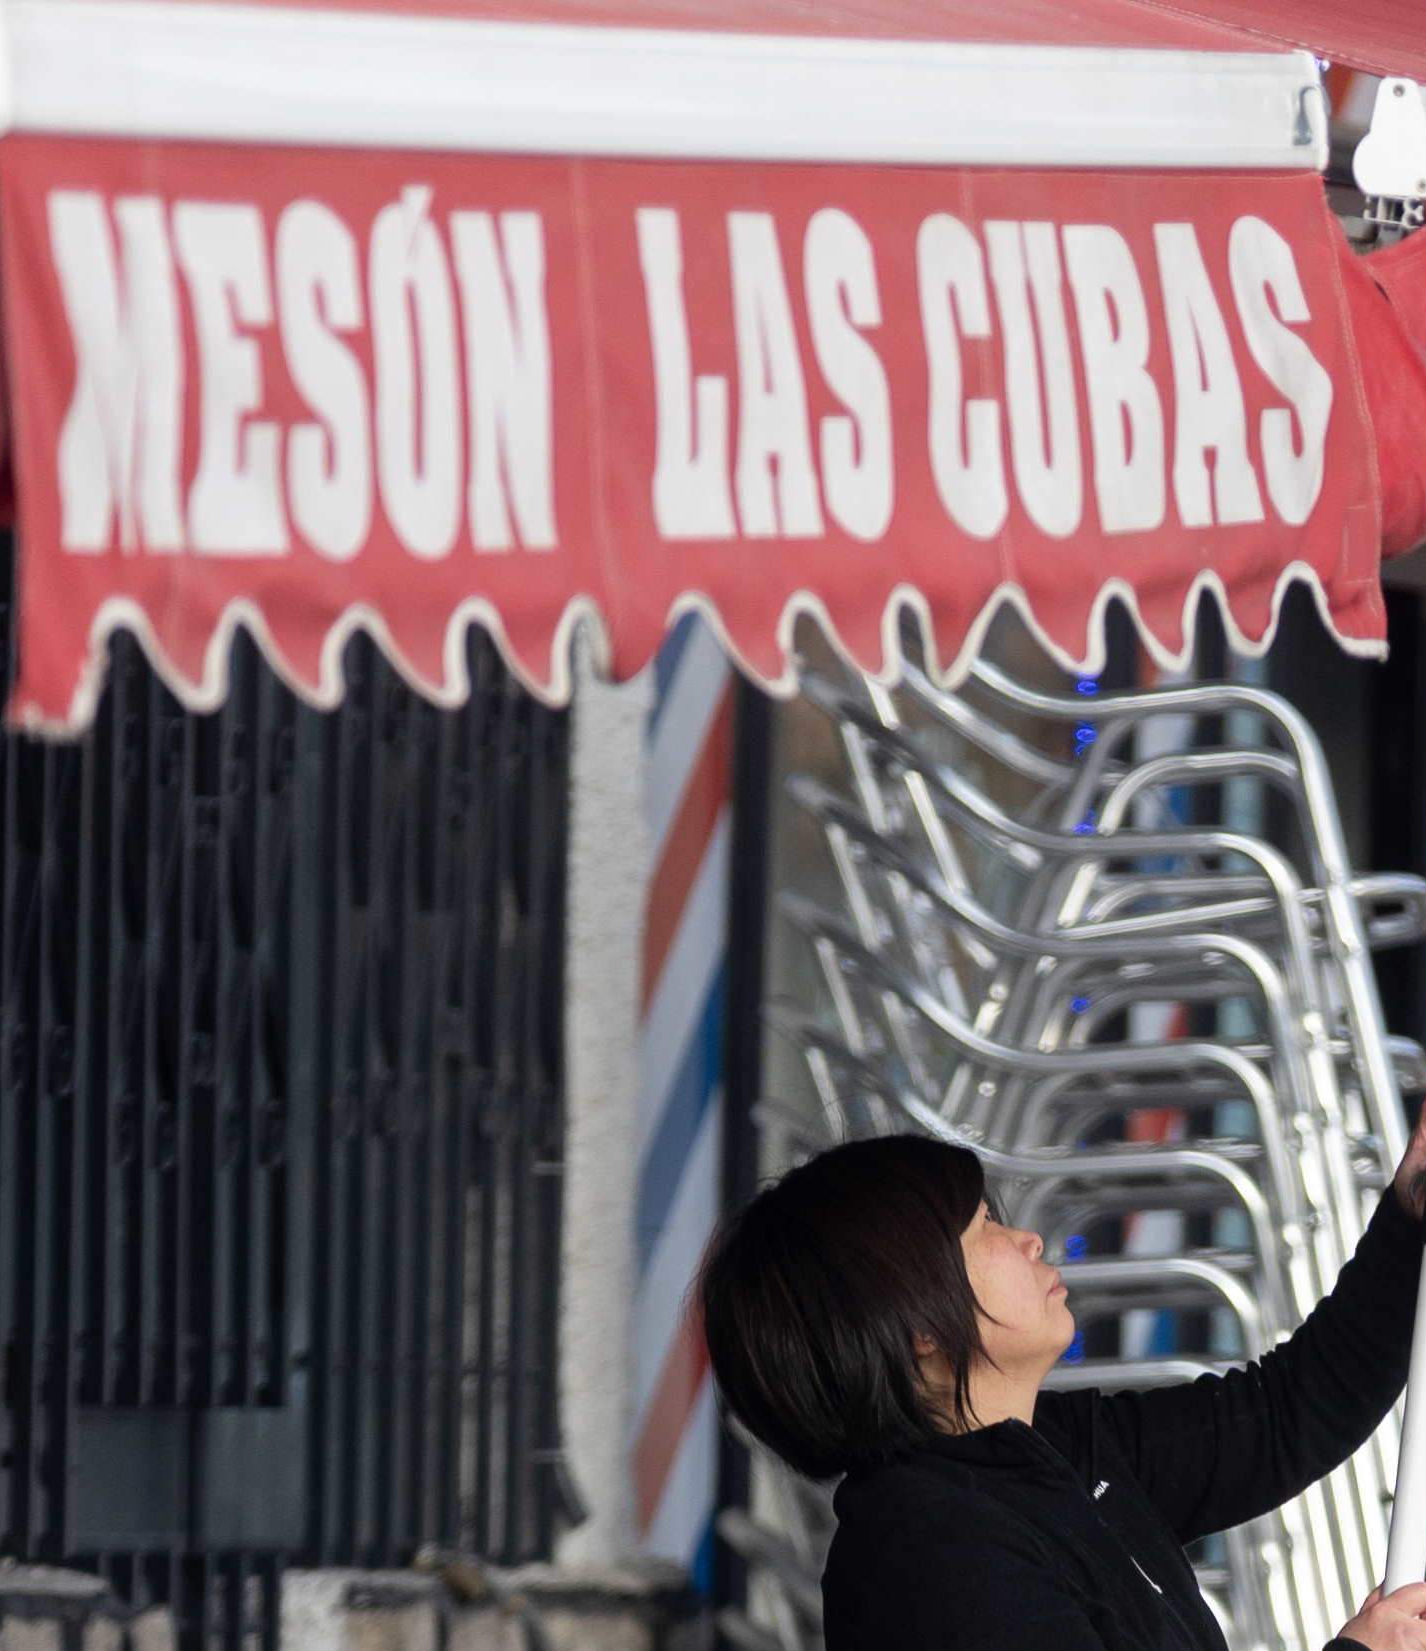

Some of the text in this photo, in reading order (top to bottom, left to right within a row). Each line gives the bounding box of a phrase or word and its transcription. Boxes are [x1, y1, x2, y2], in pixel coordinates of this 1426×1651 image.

[46, 183, 1333, 564] MESÓN LAS CUBAS
